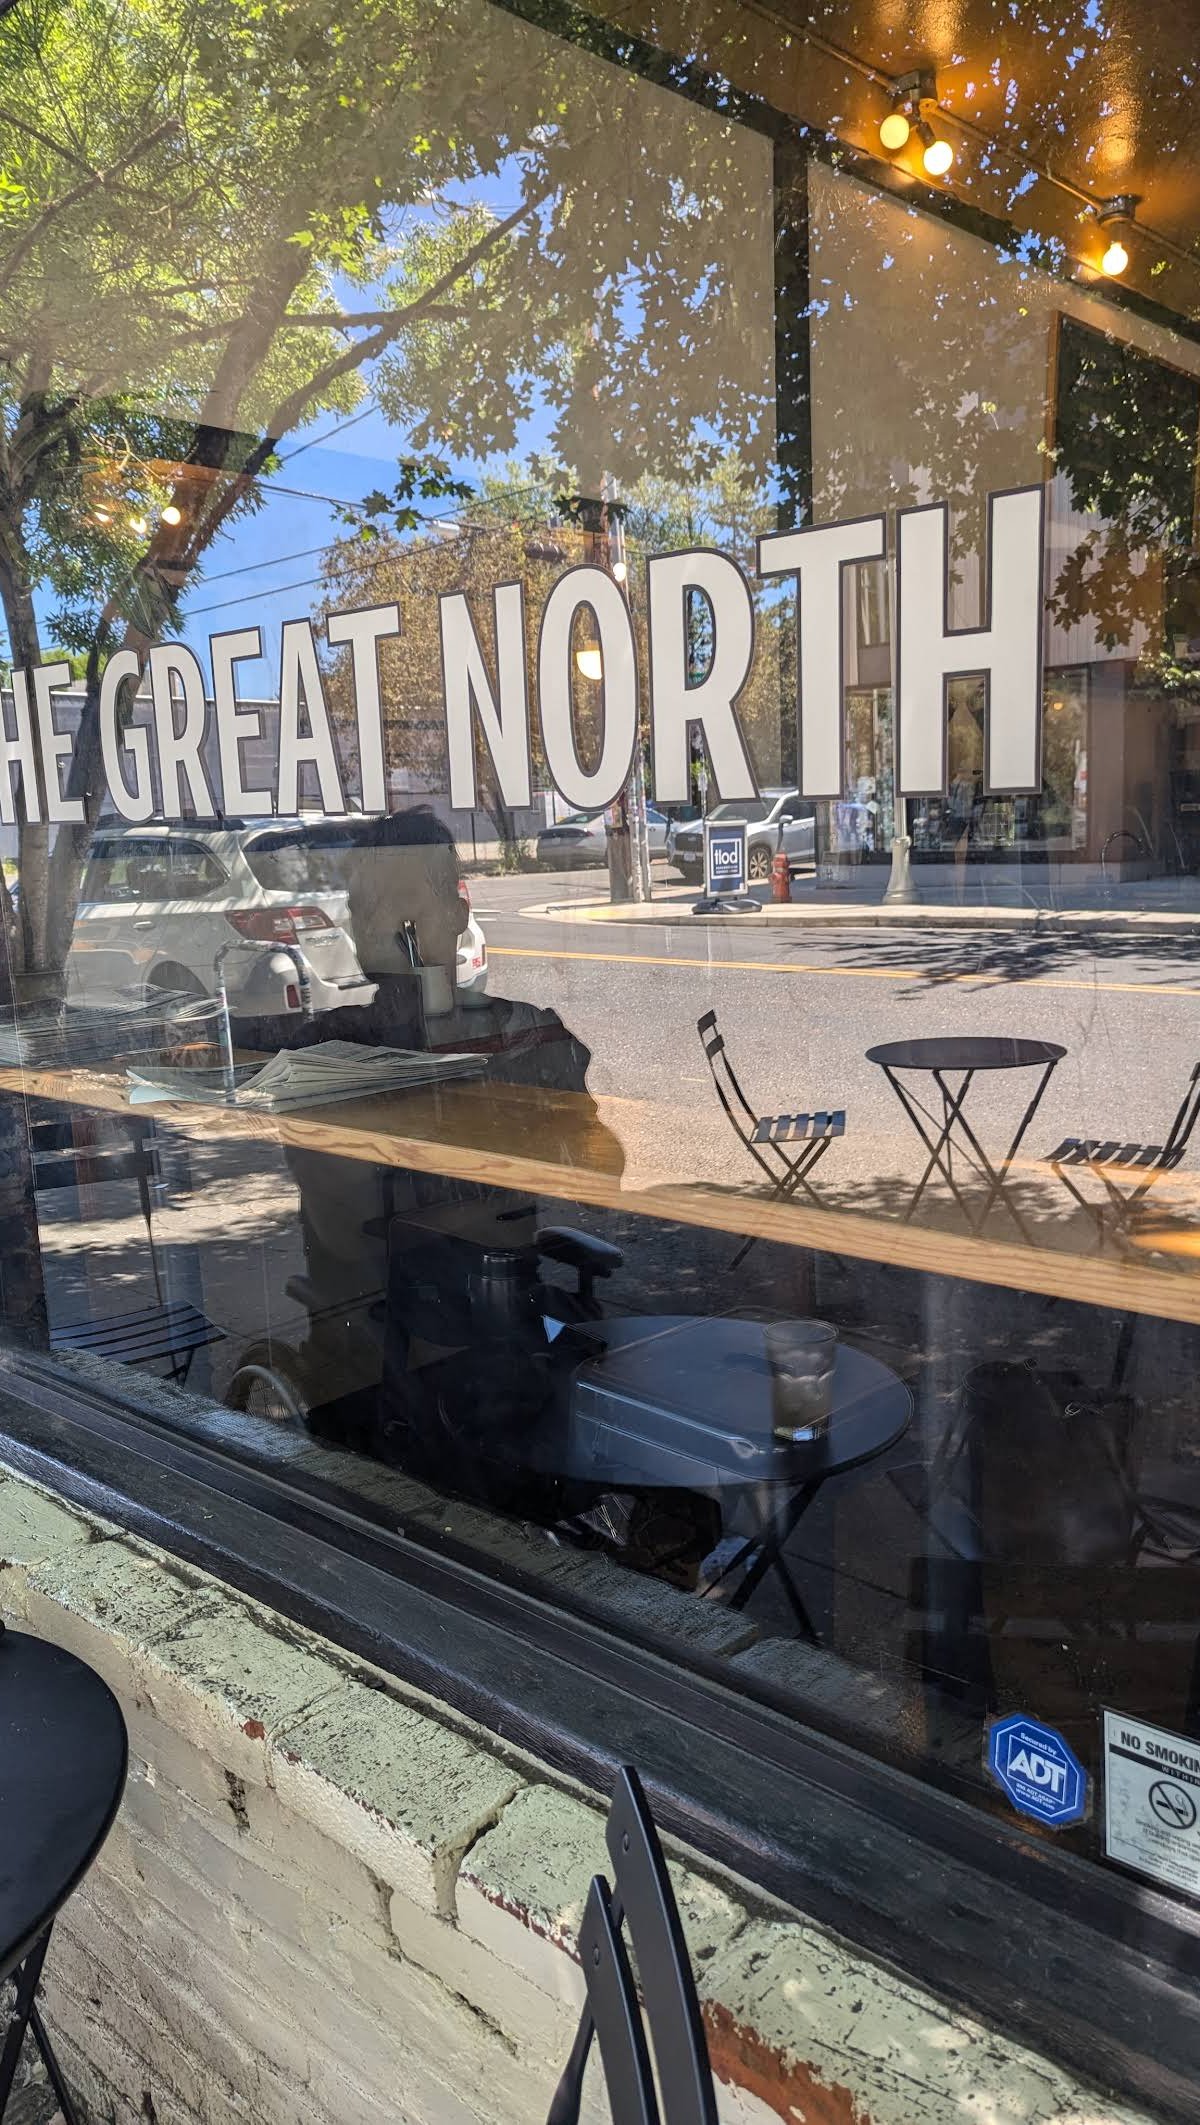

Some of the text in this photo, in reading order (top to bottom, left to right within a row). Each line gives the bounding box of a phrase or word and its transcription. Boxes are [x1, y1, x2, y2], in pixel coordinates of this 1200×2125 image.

[0, 484, 1045, 825] HE GREAT NORTH
[1020, 1732, 1057, 1756] Secured by
[1121, 1731, 1200, 1773] NO SMOKIN
[1008, 1748, 1066, 1793] ADT
